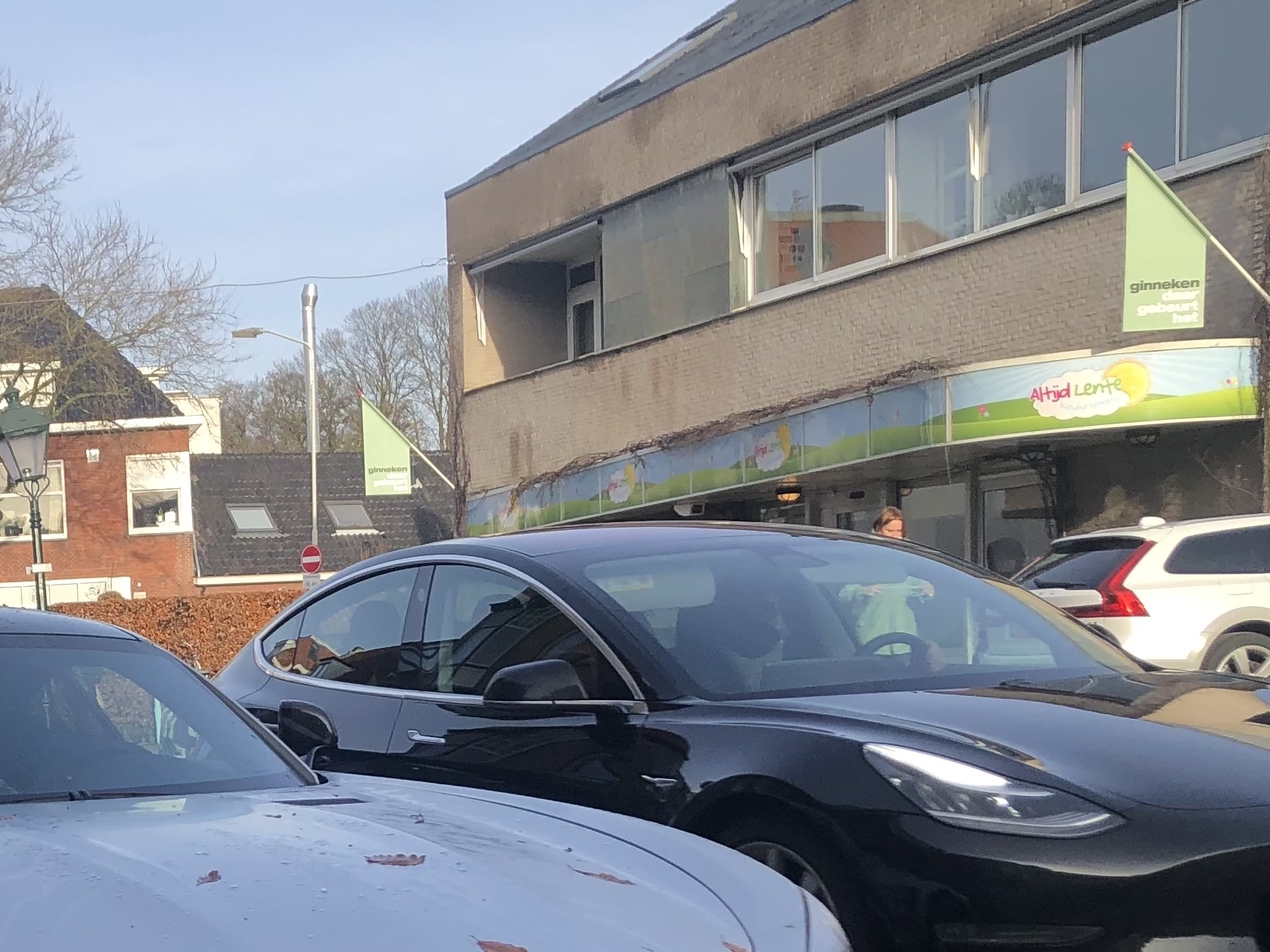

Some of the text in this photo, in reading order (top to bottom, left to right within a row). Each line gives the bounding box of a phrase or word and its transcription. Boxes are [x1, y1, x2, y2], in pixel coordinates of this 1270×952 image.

[1129, 279, 1200, 294] ginneken
[1030, 378, 1122, 402] Altijd Lente
